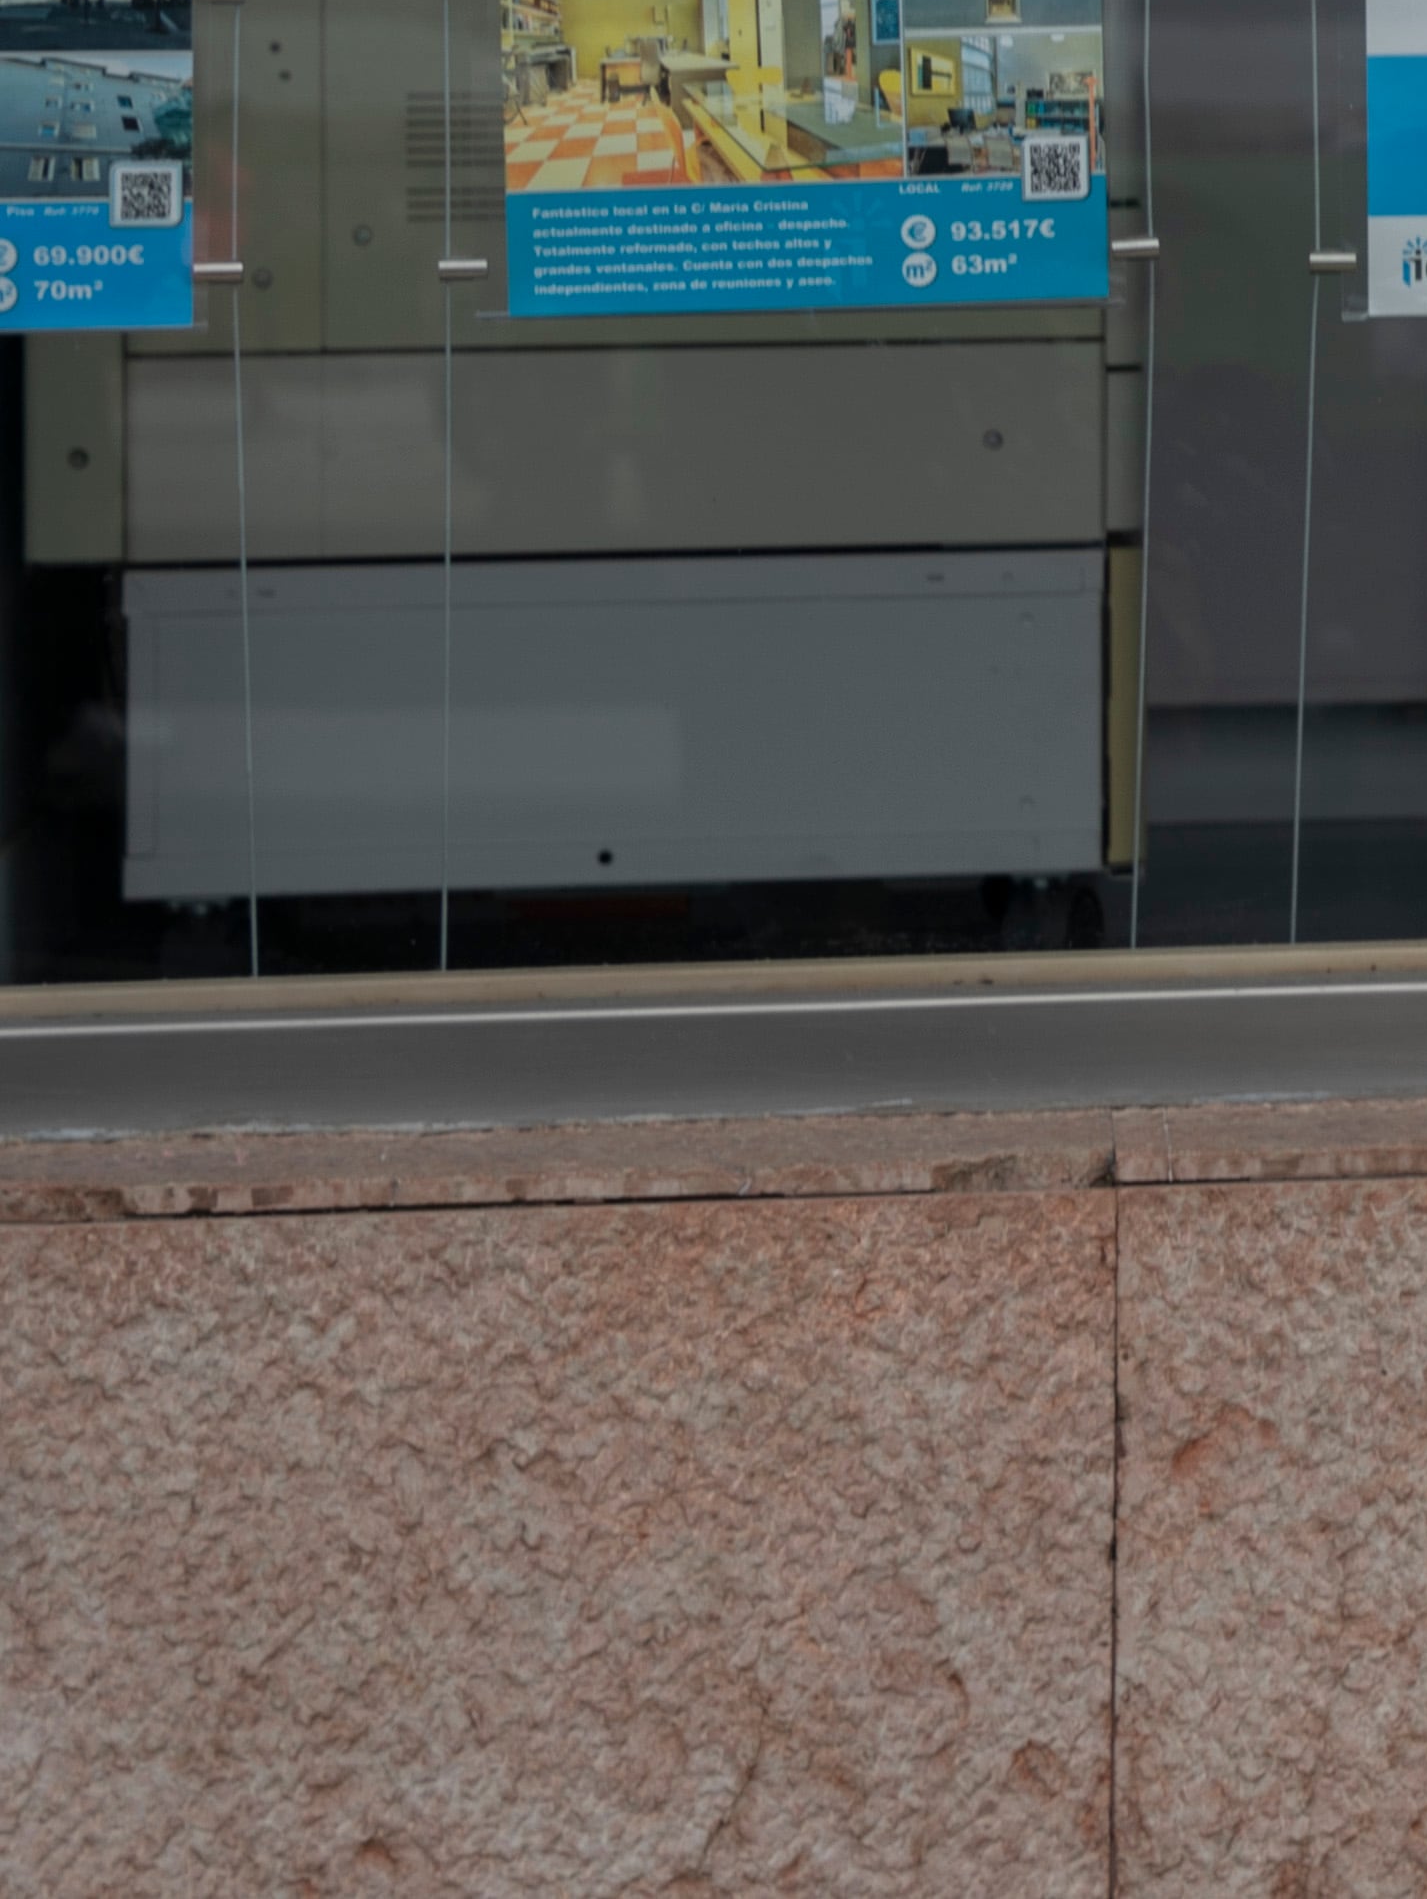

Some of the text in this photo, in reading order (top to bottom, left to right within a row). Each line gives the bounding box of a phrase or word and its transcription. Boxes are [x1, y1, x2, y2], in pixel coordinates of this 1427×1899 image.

[899, 183, 940, 194] LOCAL
[950, 219, 1055, 241] 93.517€
[34, 245, 144, 265] 69.900€
[951, 255, 1017, 276] 63m²
[34, 280, 104, 300] 70m²
